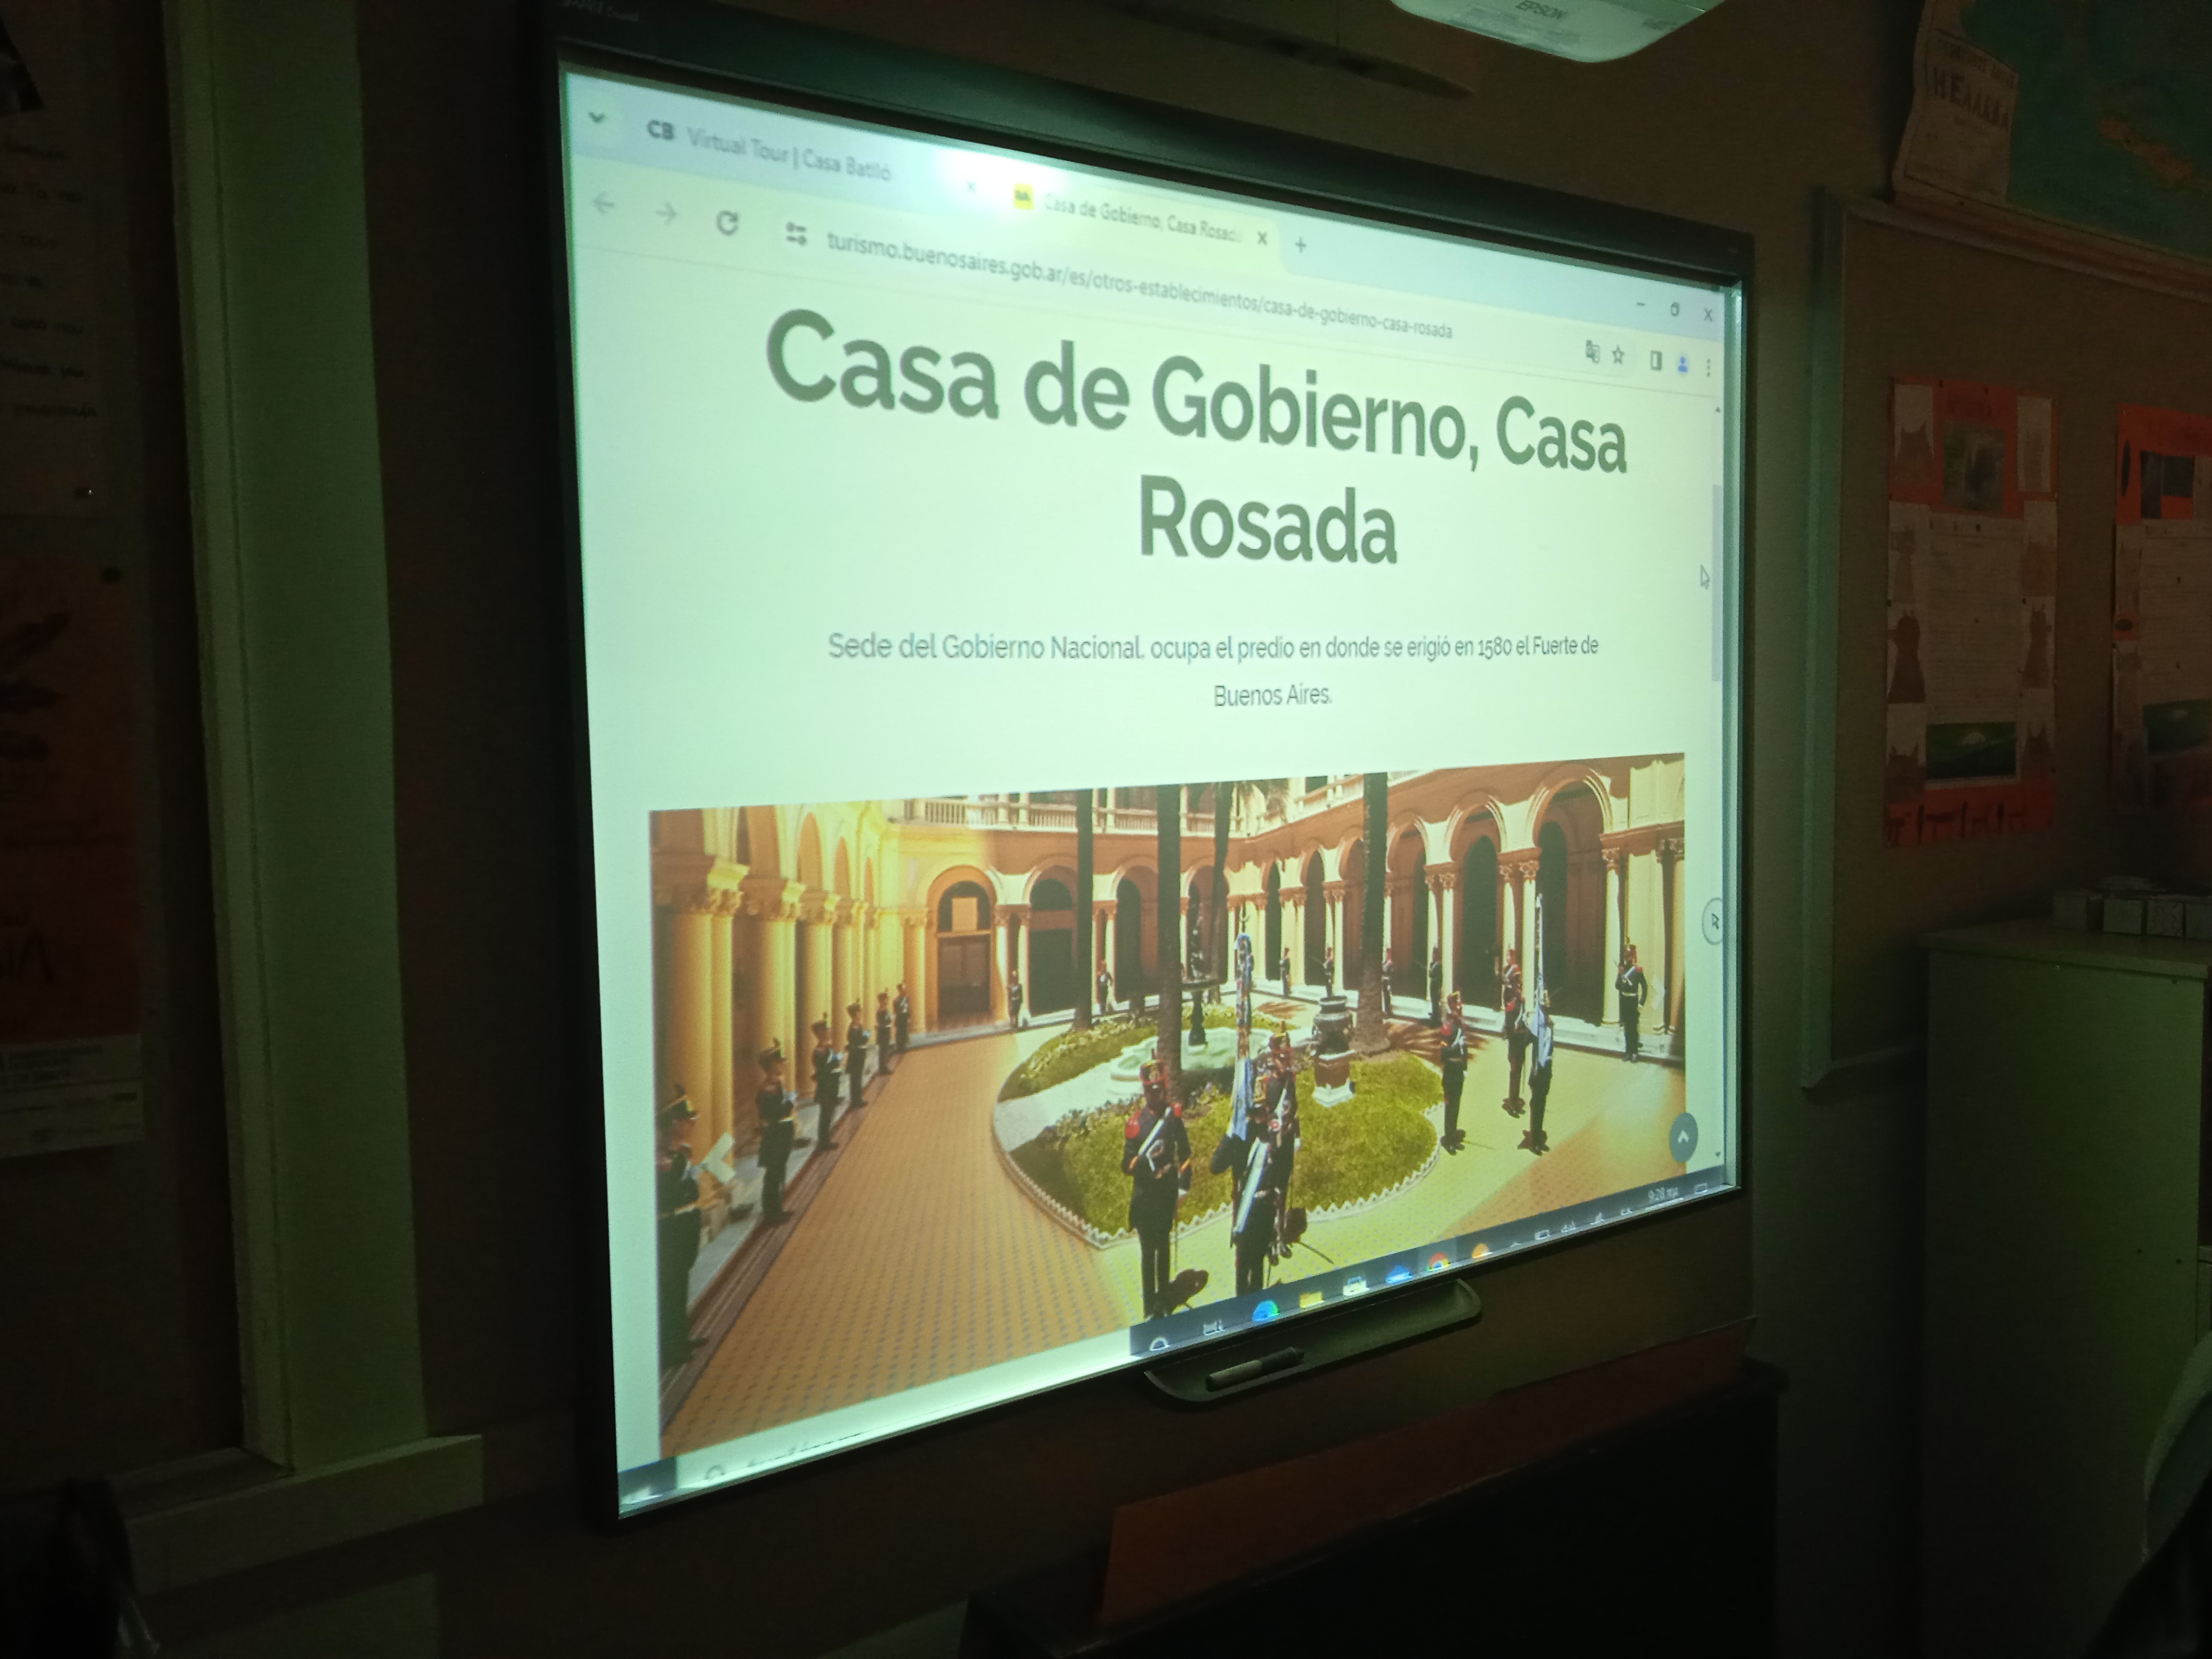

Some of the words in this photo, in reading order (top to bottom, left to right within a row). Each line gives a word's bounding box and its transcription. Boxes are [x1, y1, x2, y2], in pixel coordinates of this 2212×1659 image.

[647, 119, 675, 141] CB
[687, 127, 745, 155] Virtual
[750, 138, 790, 164] Tour
[803, 148, 841, 173] Casa
[1080, 201, 1097, 219] de
[1167, 214, 1197, 236] Casa
[766, 308, 1000, 420] Casa
[1024, 339, 1130, 431] de
[1152, 355, 1479, 472] Gobierno,
[1497, 395, 1627, 473] Casa
[1140, 473, 1398, 565] Rosada
[828, 632, 893, 658] Sede
[898, 632, 937, 659] del
[942, 633, 1045, 659] Gobierno
[1150, 640, 1212, 665] ocupa
[1216, 635, 1233, 659] el
[1237, 635, 1295, 664] predio
[1299, 639, 1322, 658] en
[1325, 635, 1381, 659] donde
[1384, 639, 1403, 658] se
[1406, 634, 1452, 663] erigió
[1454, 639, 1474, 657] en
[1478, 637, 1513, 661] 1580
[1515, 635, 1530, 657] el
[1532, 635, 1578, 657] Fuerte
[1580, 635, 1600, 656] de
[1213, 684, 1283, 708] Buenos
[1285, 681, 1334, 706] Aires.
